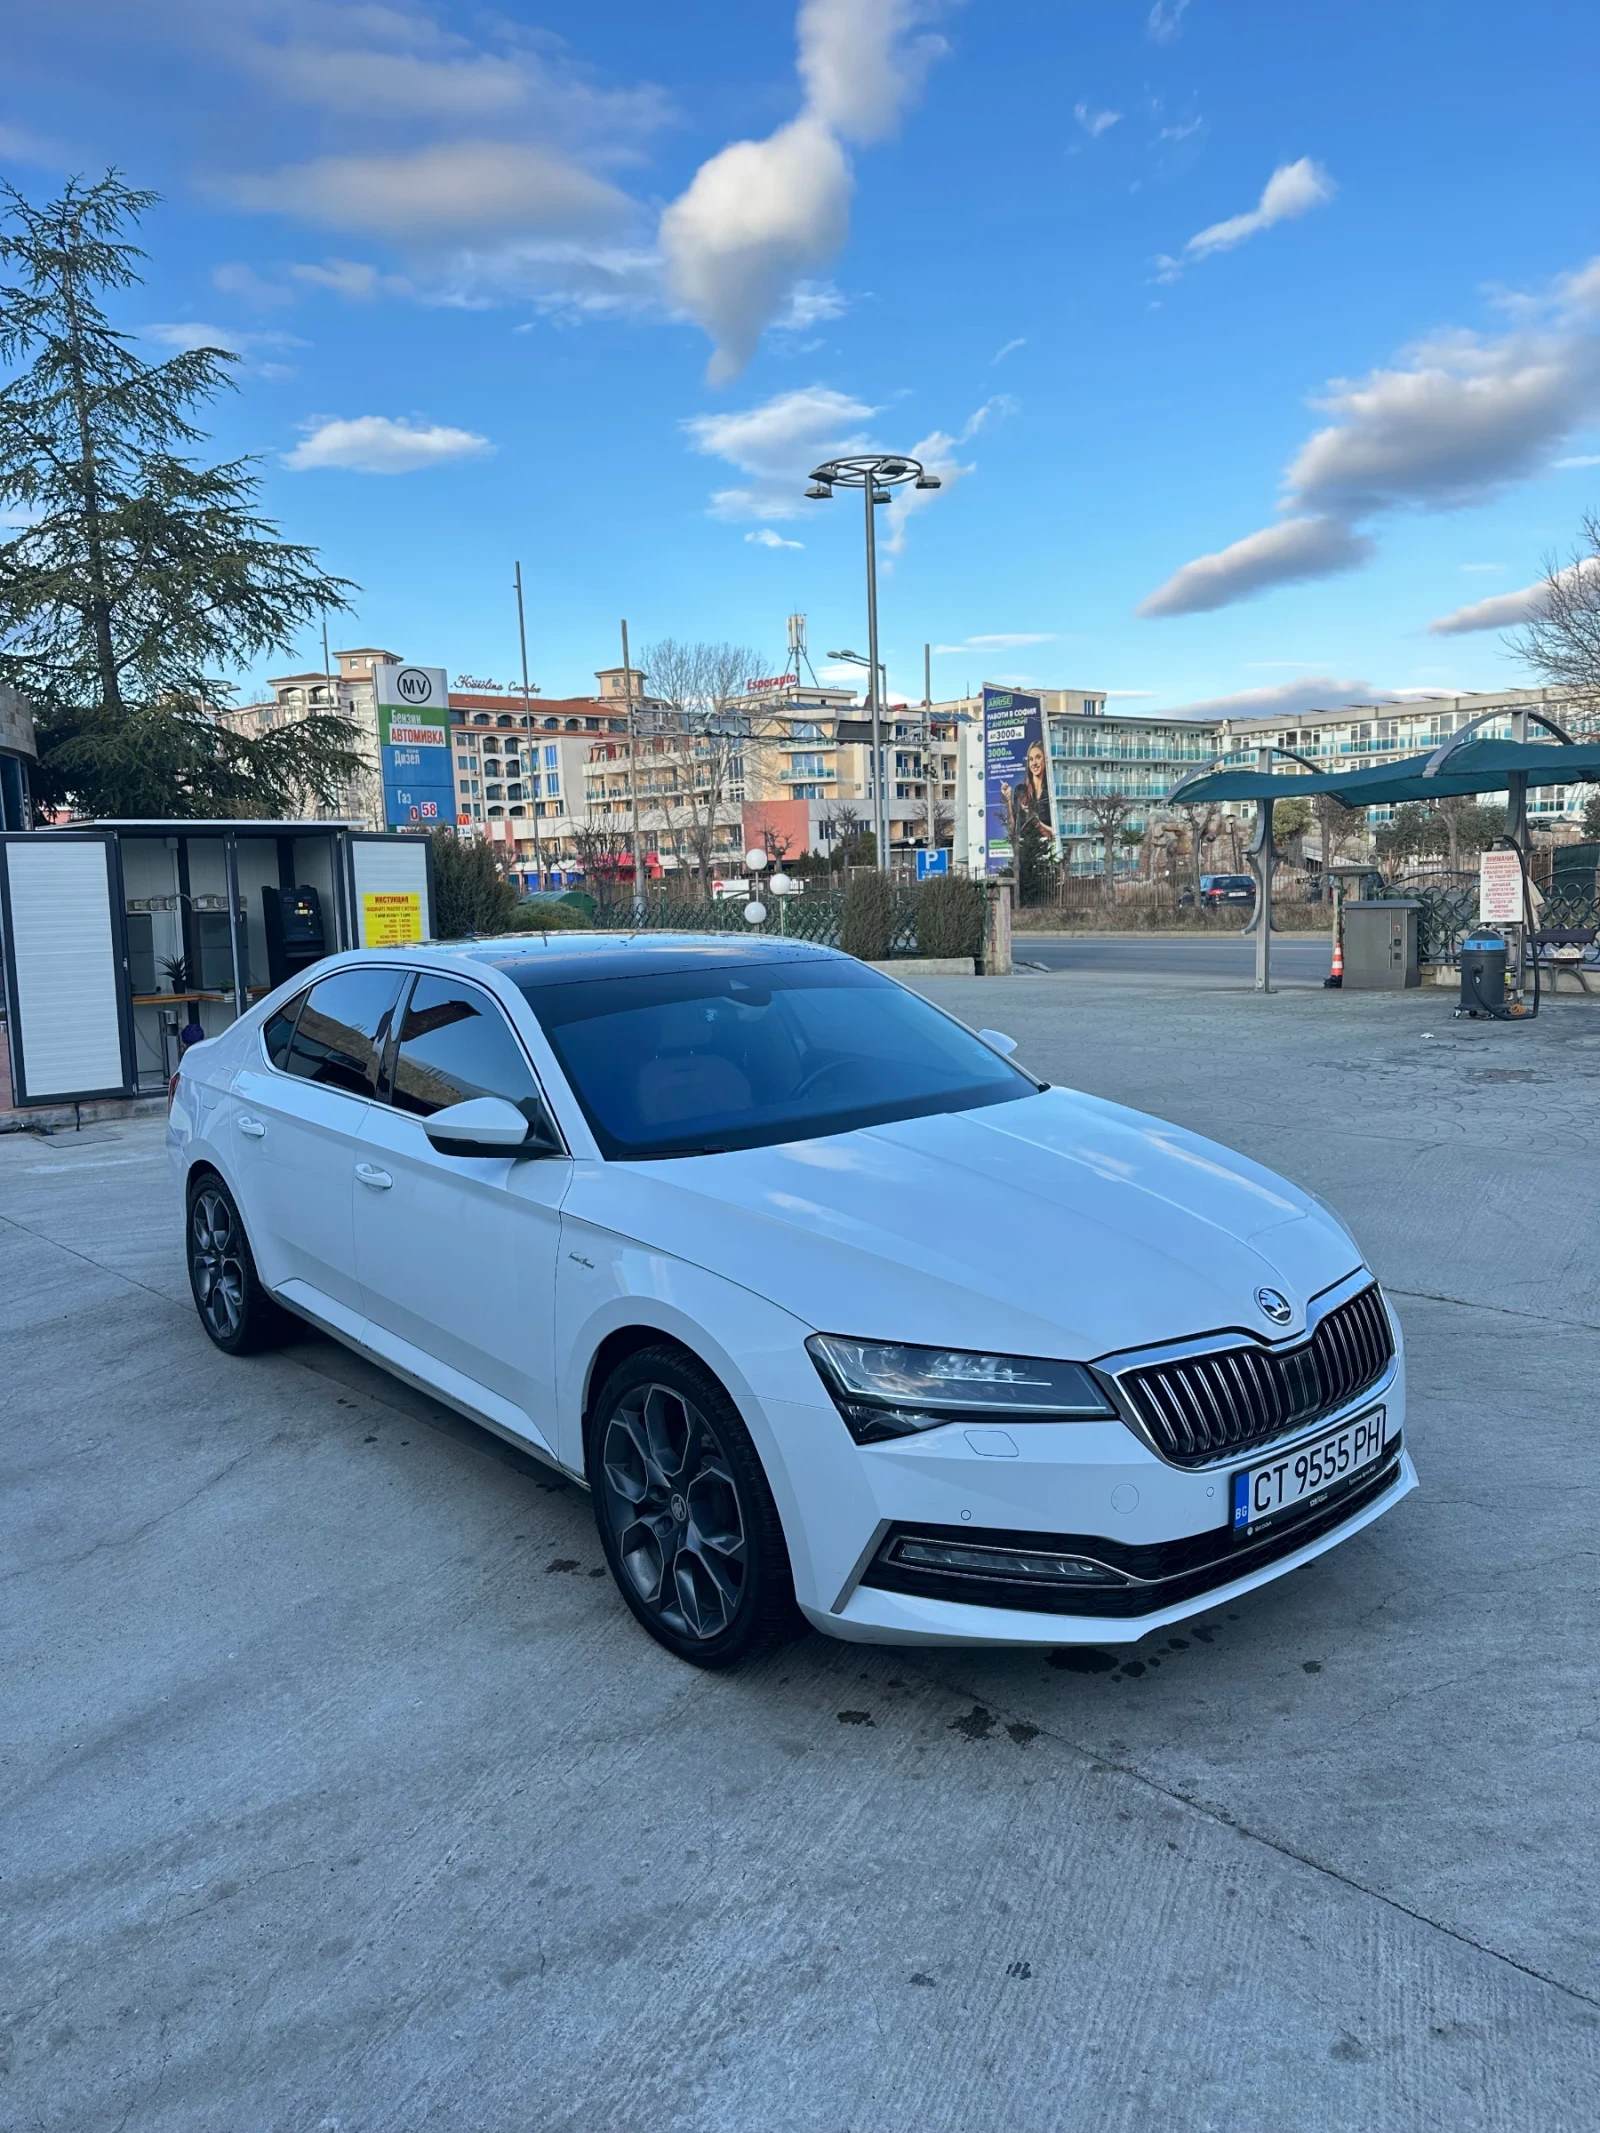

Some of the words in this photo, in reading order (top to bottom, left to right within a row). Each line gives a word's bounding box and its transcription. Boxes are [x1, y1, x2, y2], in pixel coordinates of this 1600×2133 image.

[403, 678, 426, 695] MV
[747, 673, 796, 691] Esperanto
[988, 697, 1012, 707] ARRISE
[391, 709, 421, 724] Бензин
[987, 711, 1008, 720] РАБОТИ
[1009, 710, 1013, 718] В
[1014, 707, 1037, 717] СОФИЯ
[391, 728, 444, 744] АВТОМИВКА
[996, 729, 1015, 739] 3000
[394, 750, 420, 767] Дизел
[397, 790, 412, 804] Газ
[1294, 1434, 1350, 1495] 9555
[1235, 1506, 1248, 1520] BG
